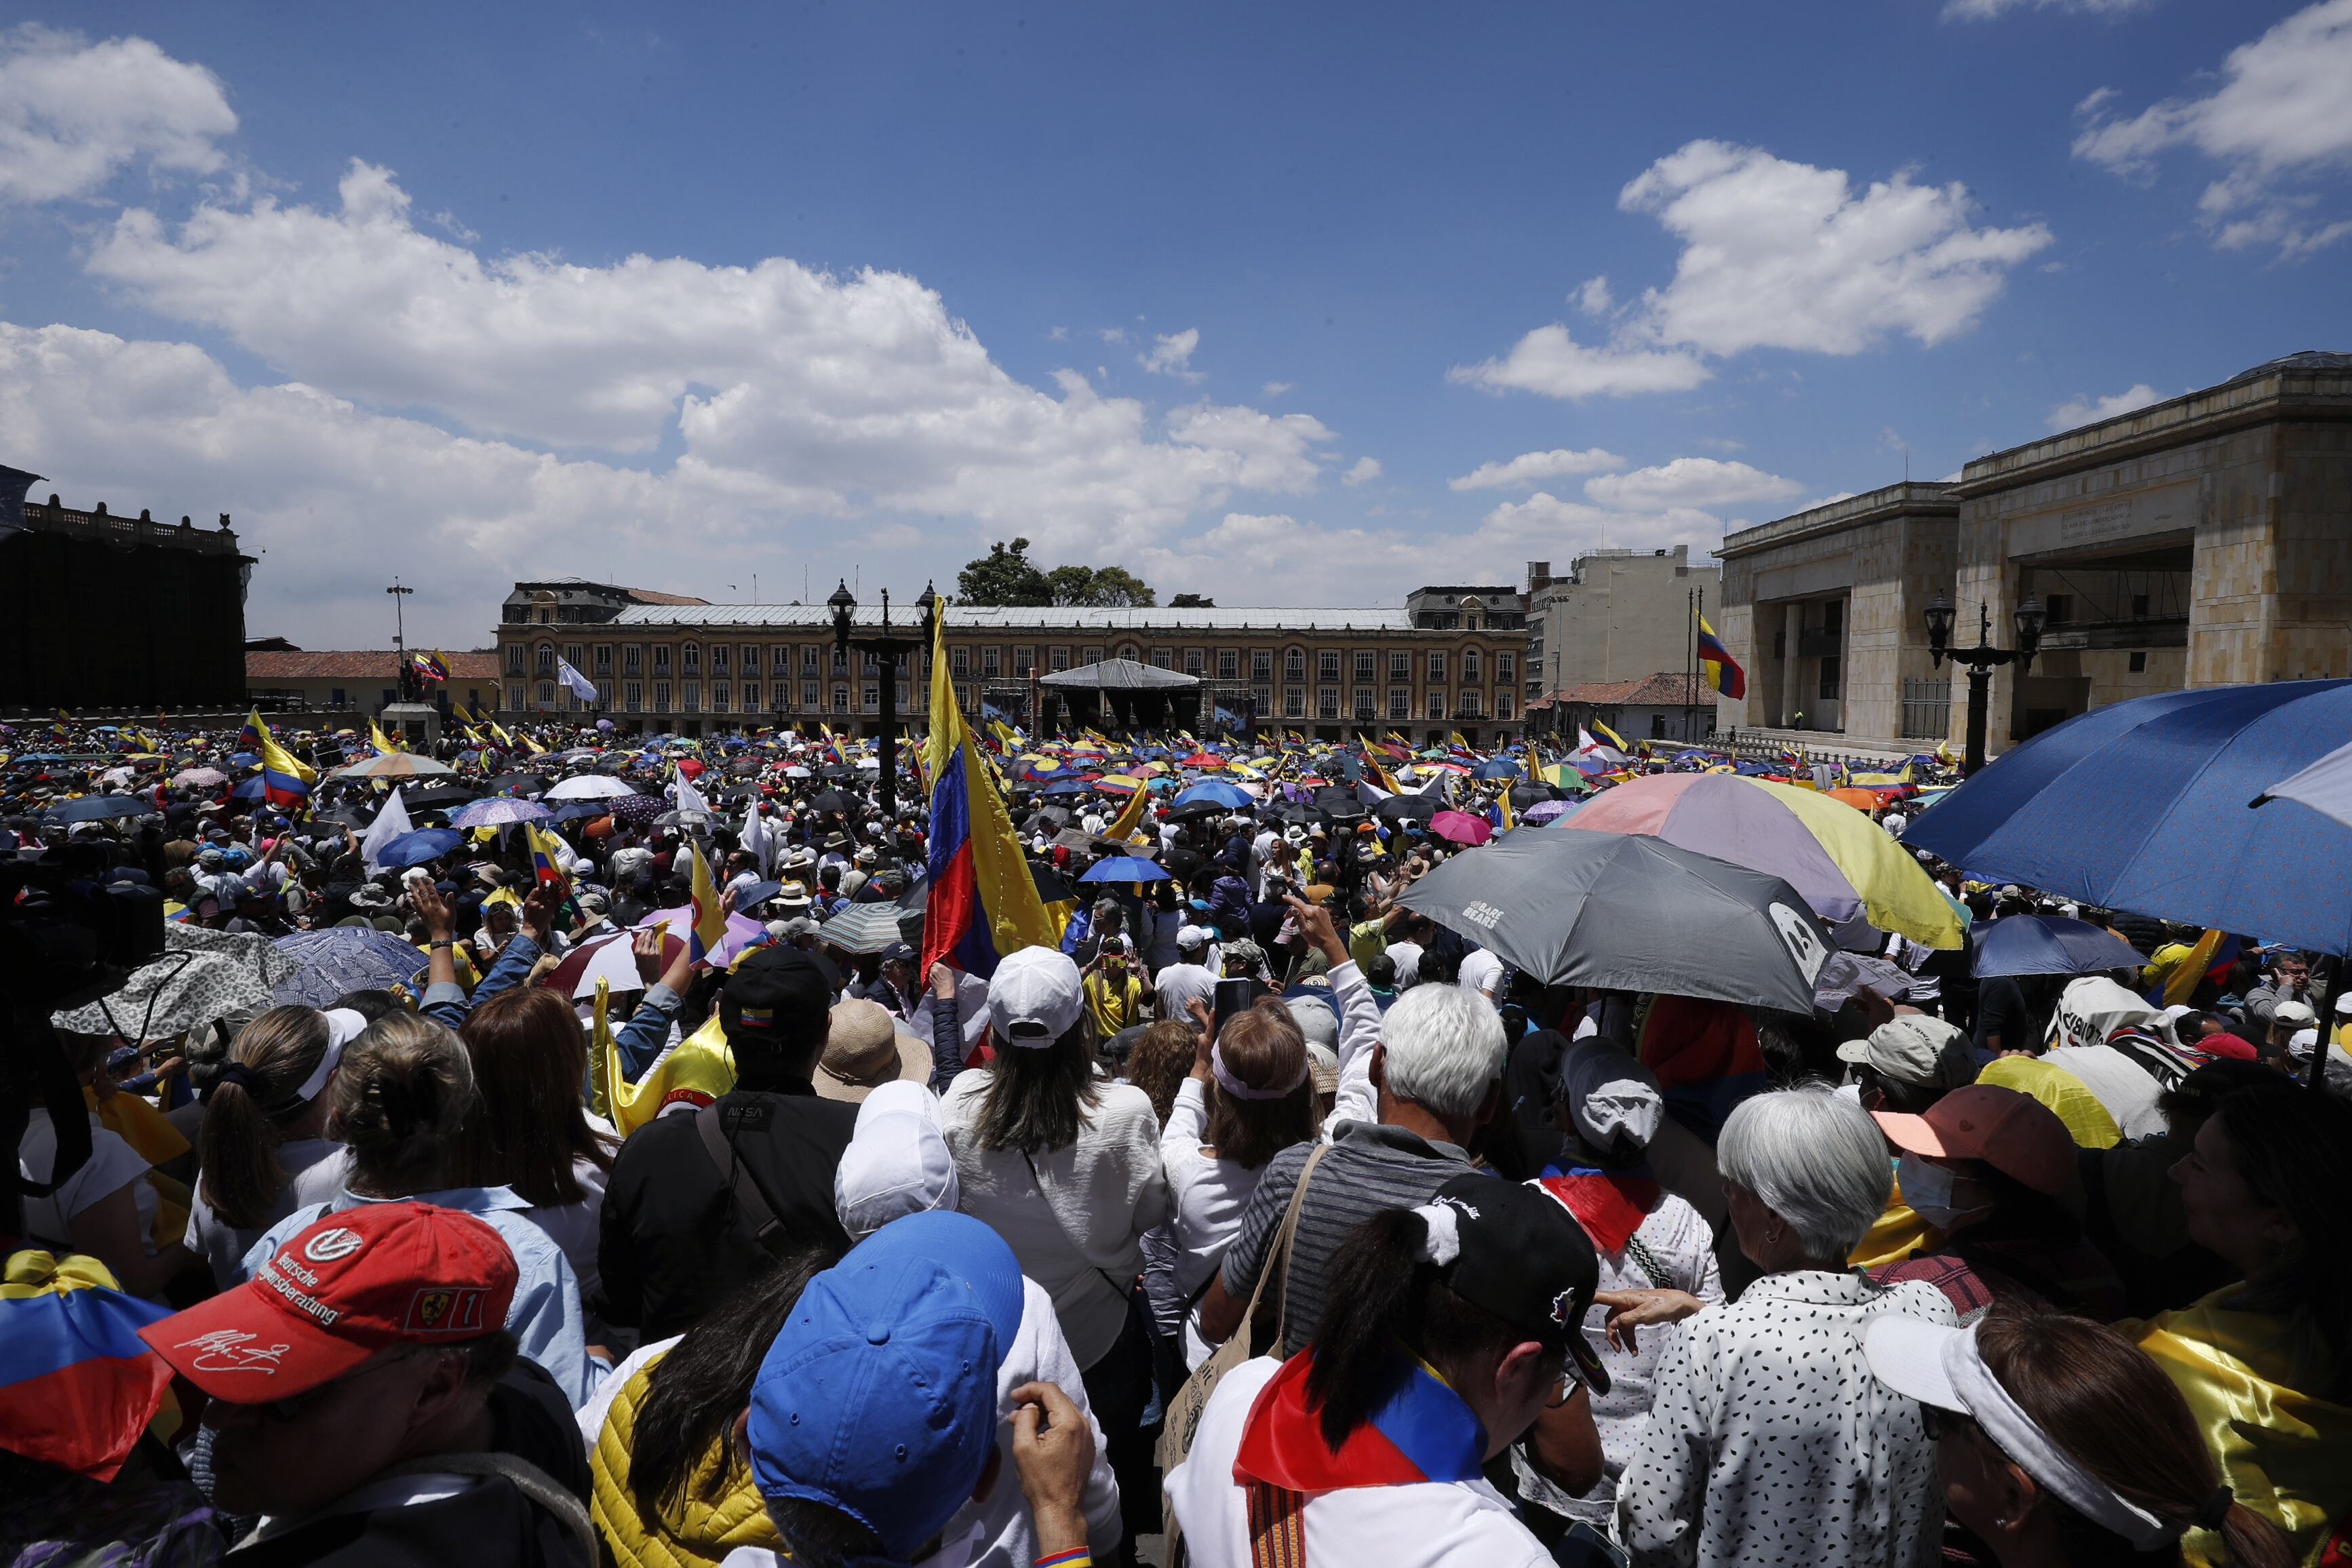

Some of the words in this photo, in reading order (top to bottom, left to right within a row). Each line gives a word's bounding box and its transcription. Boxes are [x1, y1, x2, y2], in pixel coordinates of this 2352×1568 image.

[1462, 906, 1497, 930] BEARS
[1478, 903, 1505, 920] BARE
[463, 1293, 477, 1325] 1
